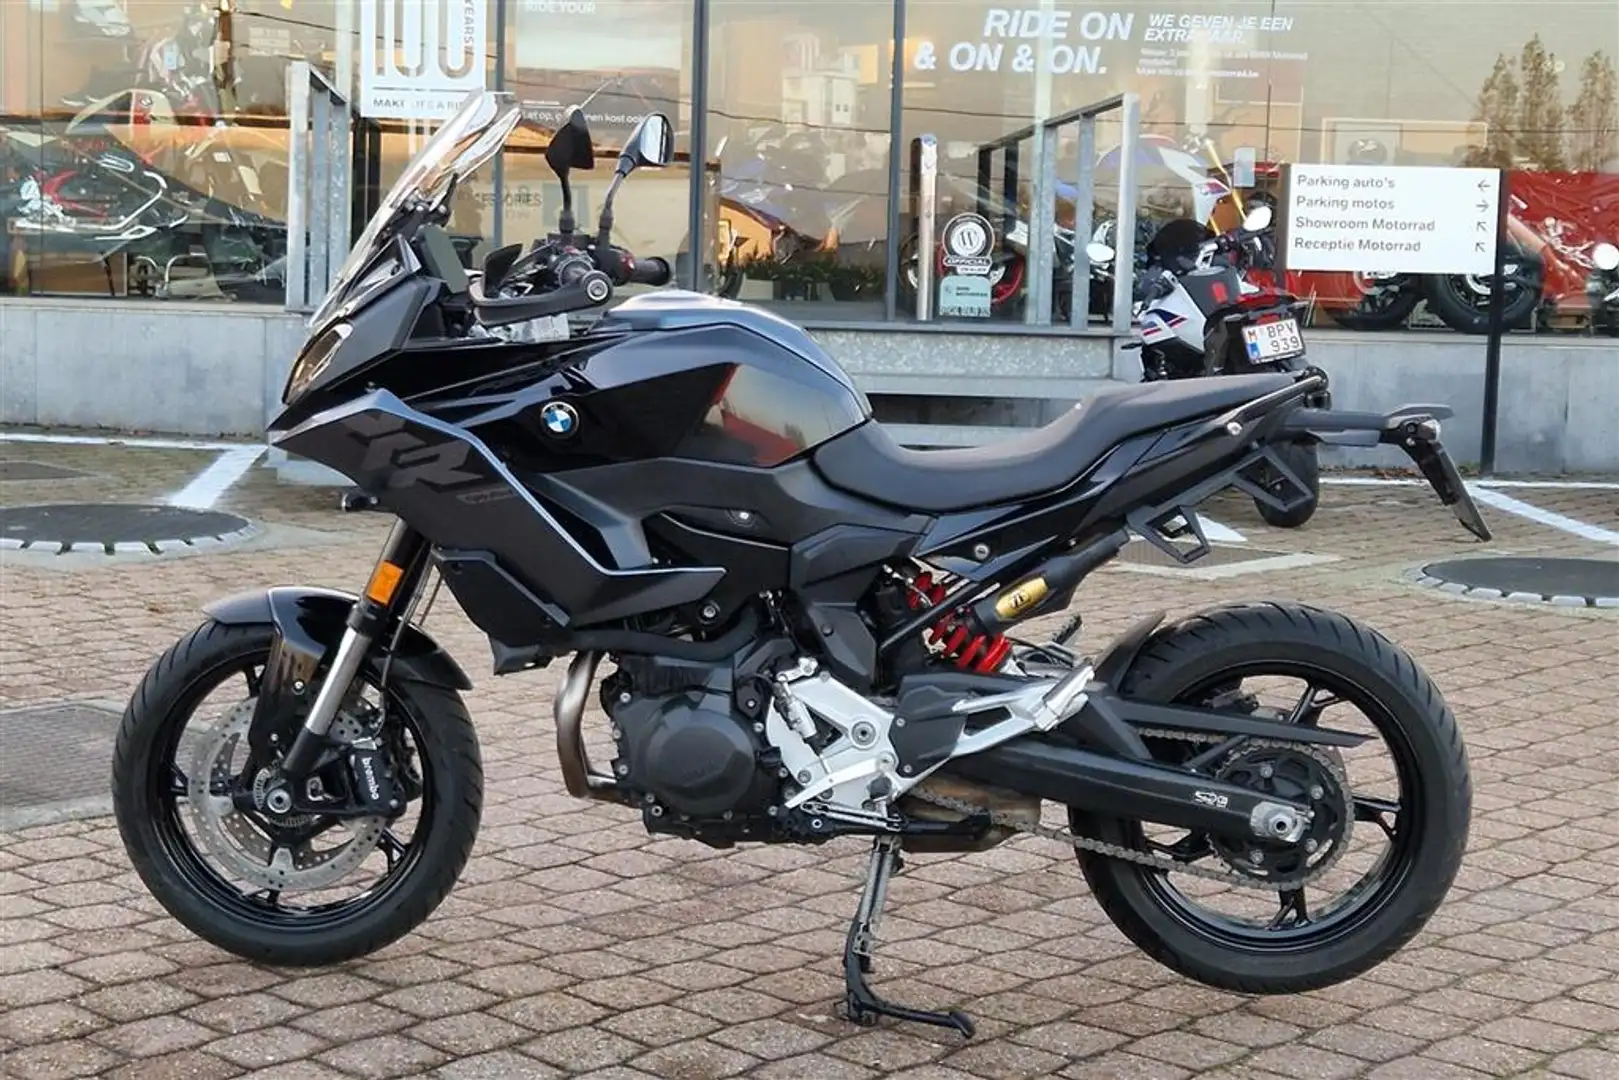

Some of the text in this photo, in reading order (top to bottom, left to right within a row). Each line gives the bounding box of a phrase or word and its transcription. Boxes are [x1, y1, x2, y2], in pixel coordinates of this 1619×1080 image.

[983, 8, 1135, 41] RIDE ON
[1149, 13, 1294, 31] WE GEVEN JE EEN
[913, 41, 937, 71] &
[950, 41, 1004, 72] ON
[1012, 43, 1035, 73] &
[1049, 44, 1107, 75] ON.
[1297, 174, 1395, 190] Parking auto's
[1296, 195, 1395, 211] Parking motos
[1295, 216, 1436, 232] Showroom Motorrad
[1294, 237, 1421, 252] Receptie Motorrad
[1270, 335, 1300, 352] 939
